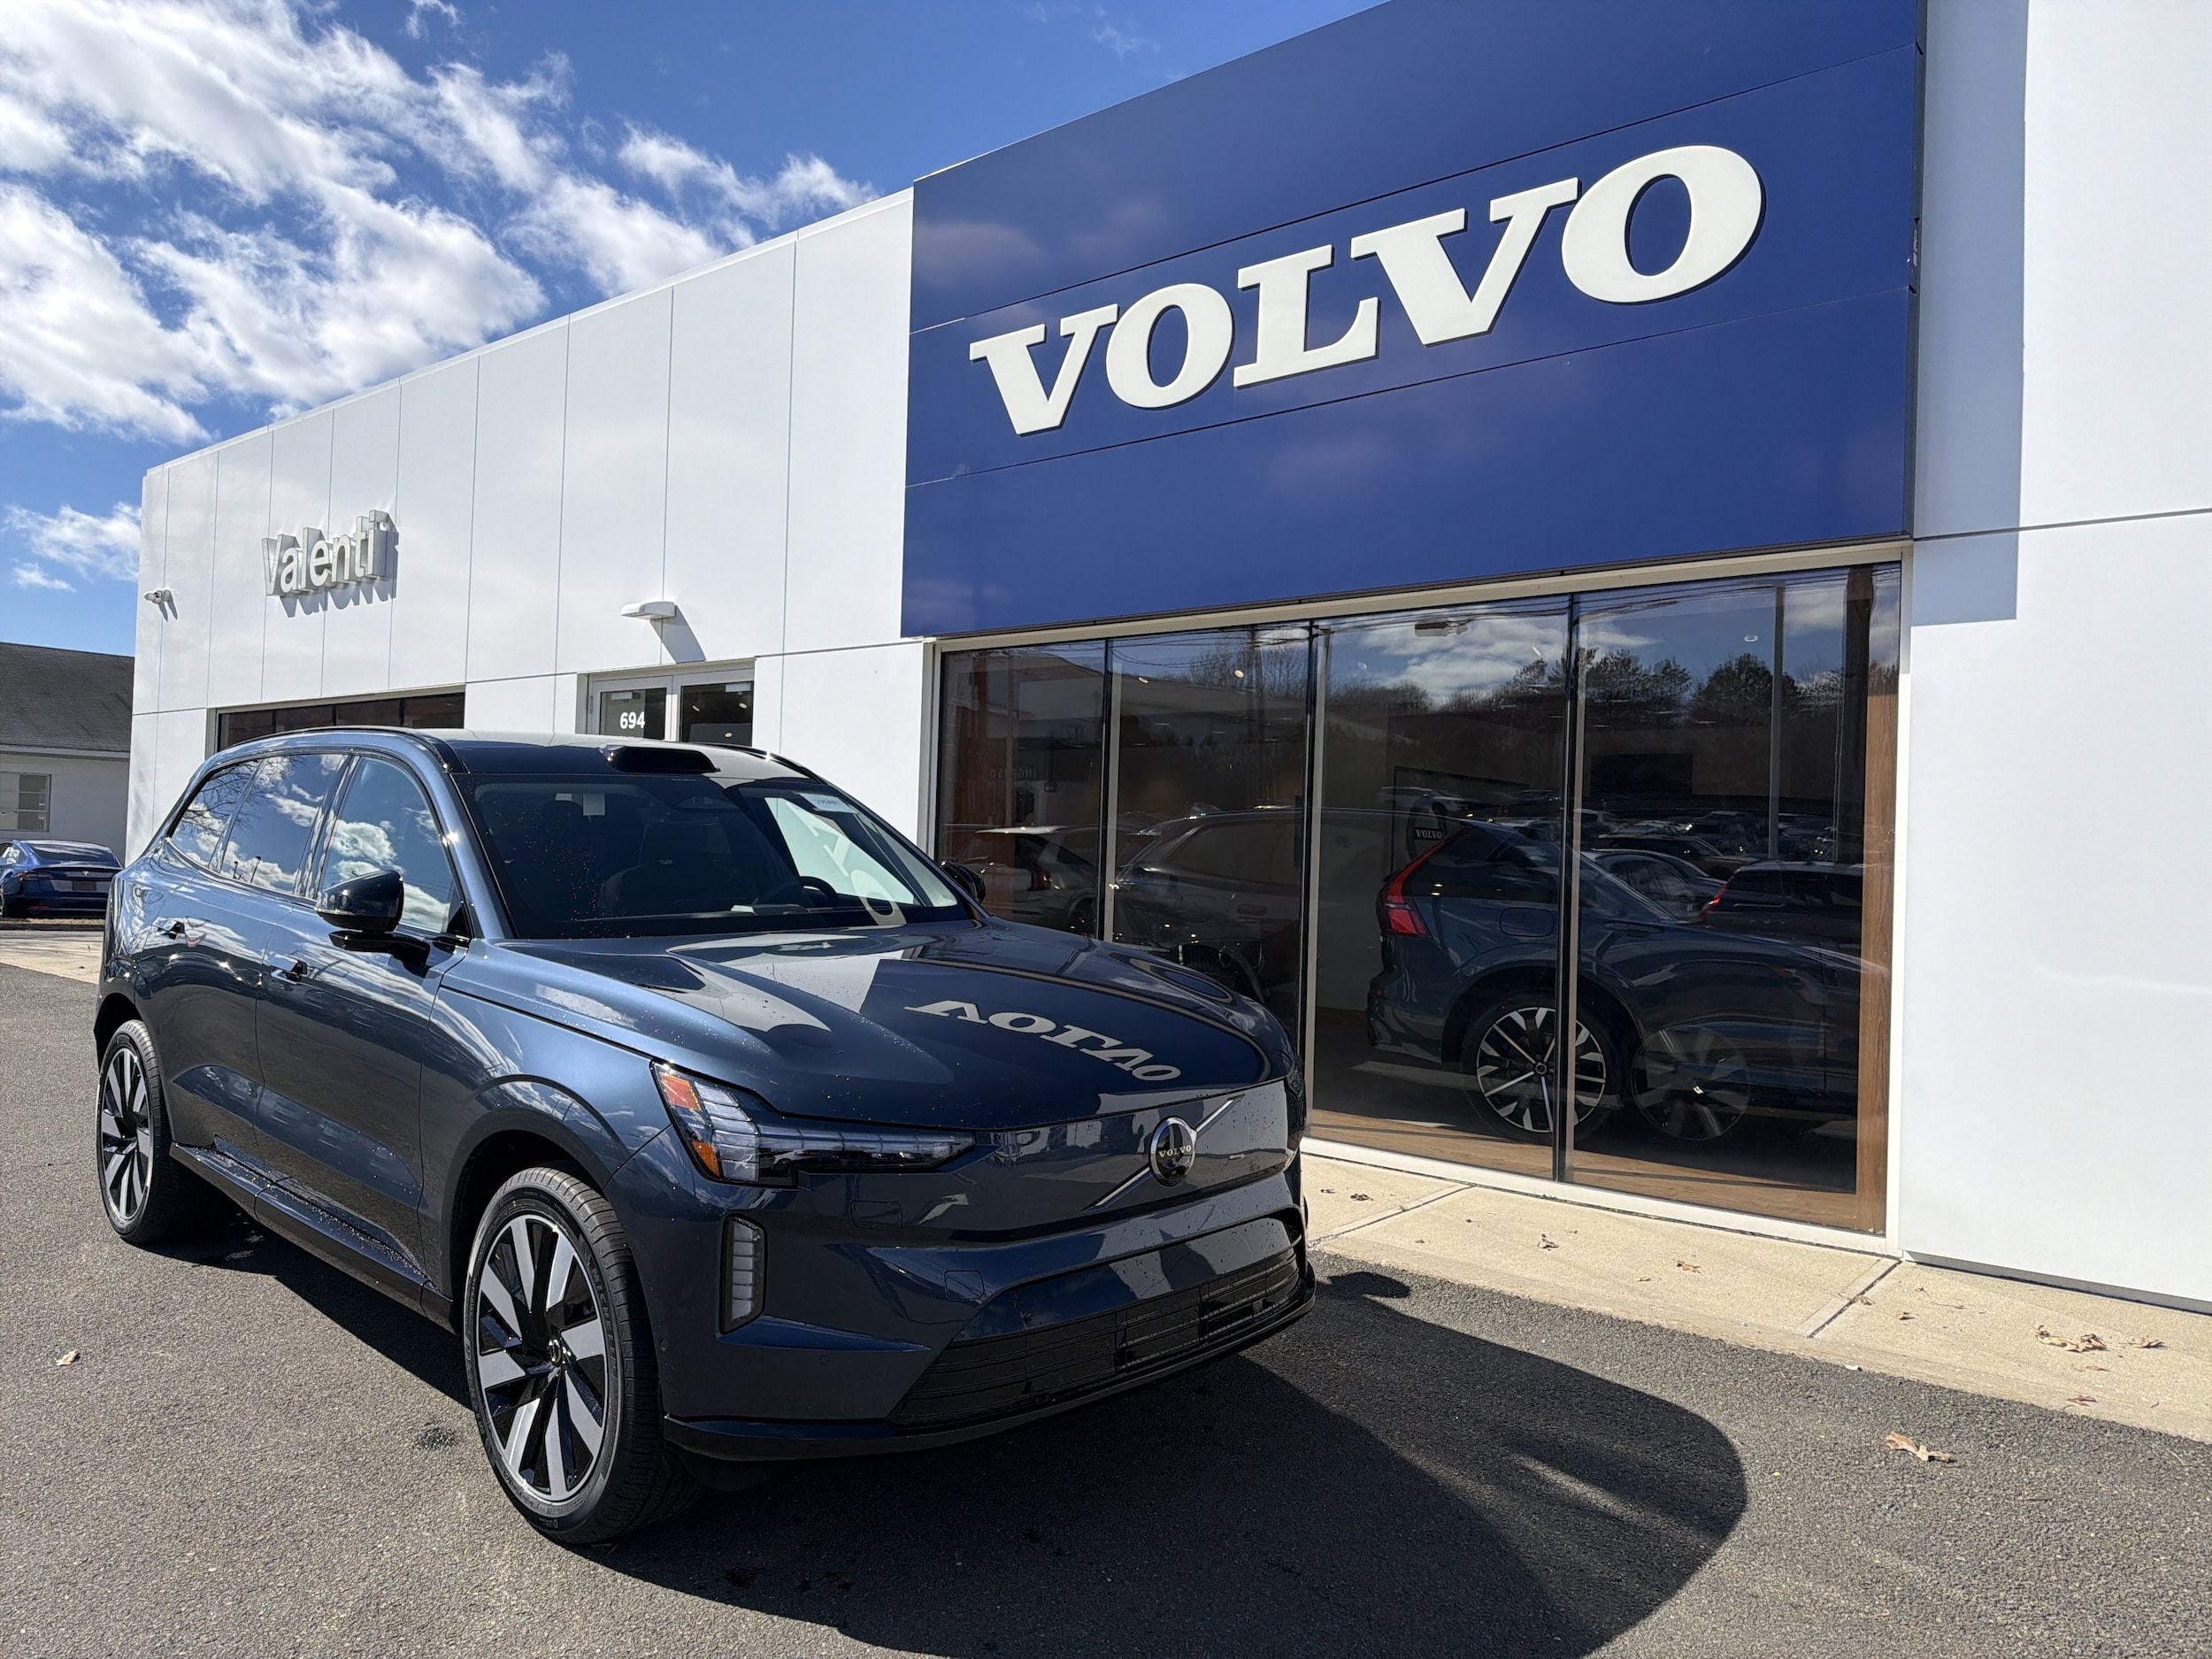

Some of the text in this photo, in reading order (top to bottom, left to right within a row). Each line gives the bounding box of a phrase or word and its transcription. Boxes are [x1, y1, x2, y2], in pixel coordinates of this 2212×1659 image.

[969, 144, 1764, 436] VOLVO
[262, 510, 385, 596] Valenti
[619, 711, 645, 729] 694
[1416, 829, 1443, 840] VOLVO
[1157, 1144, 1192, 1158] VOLVO
